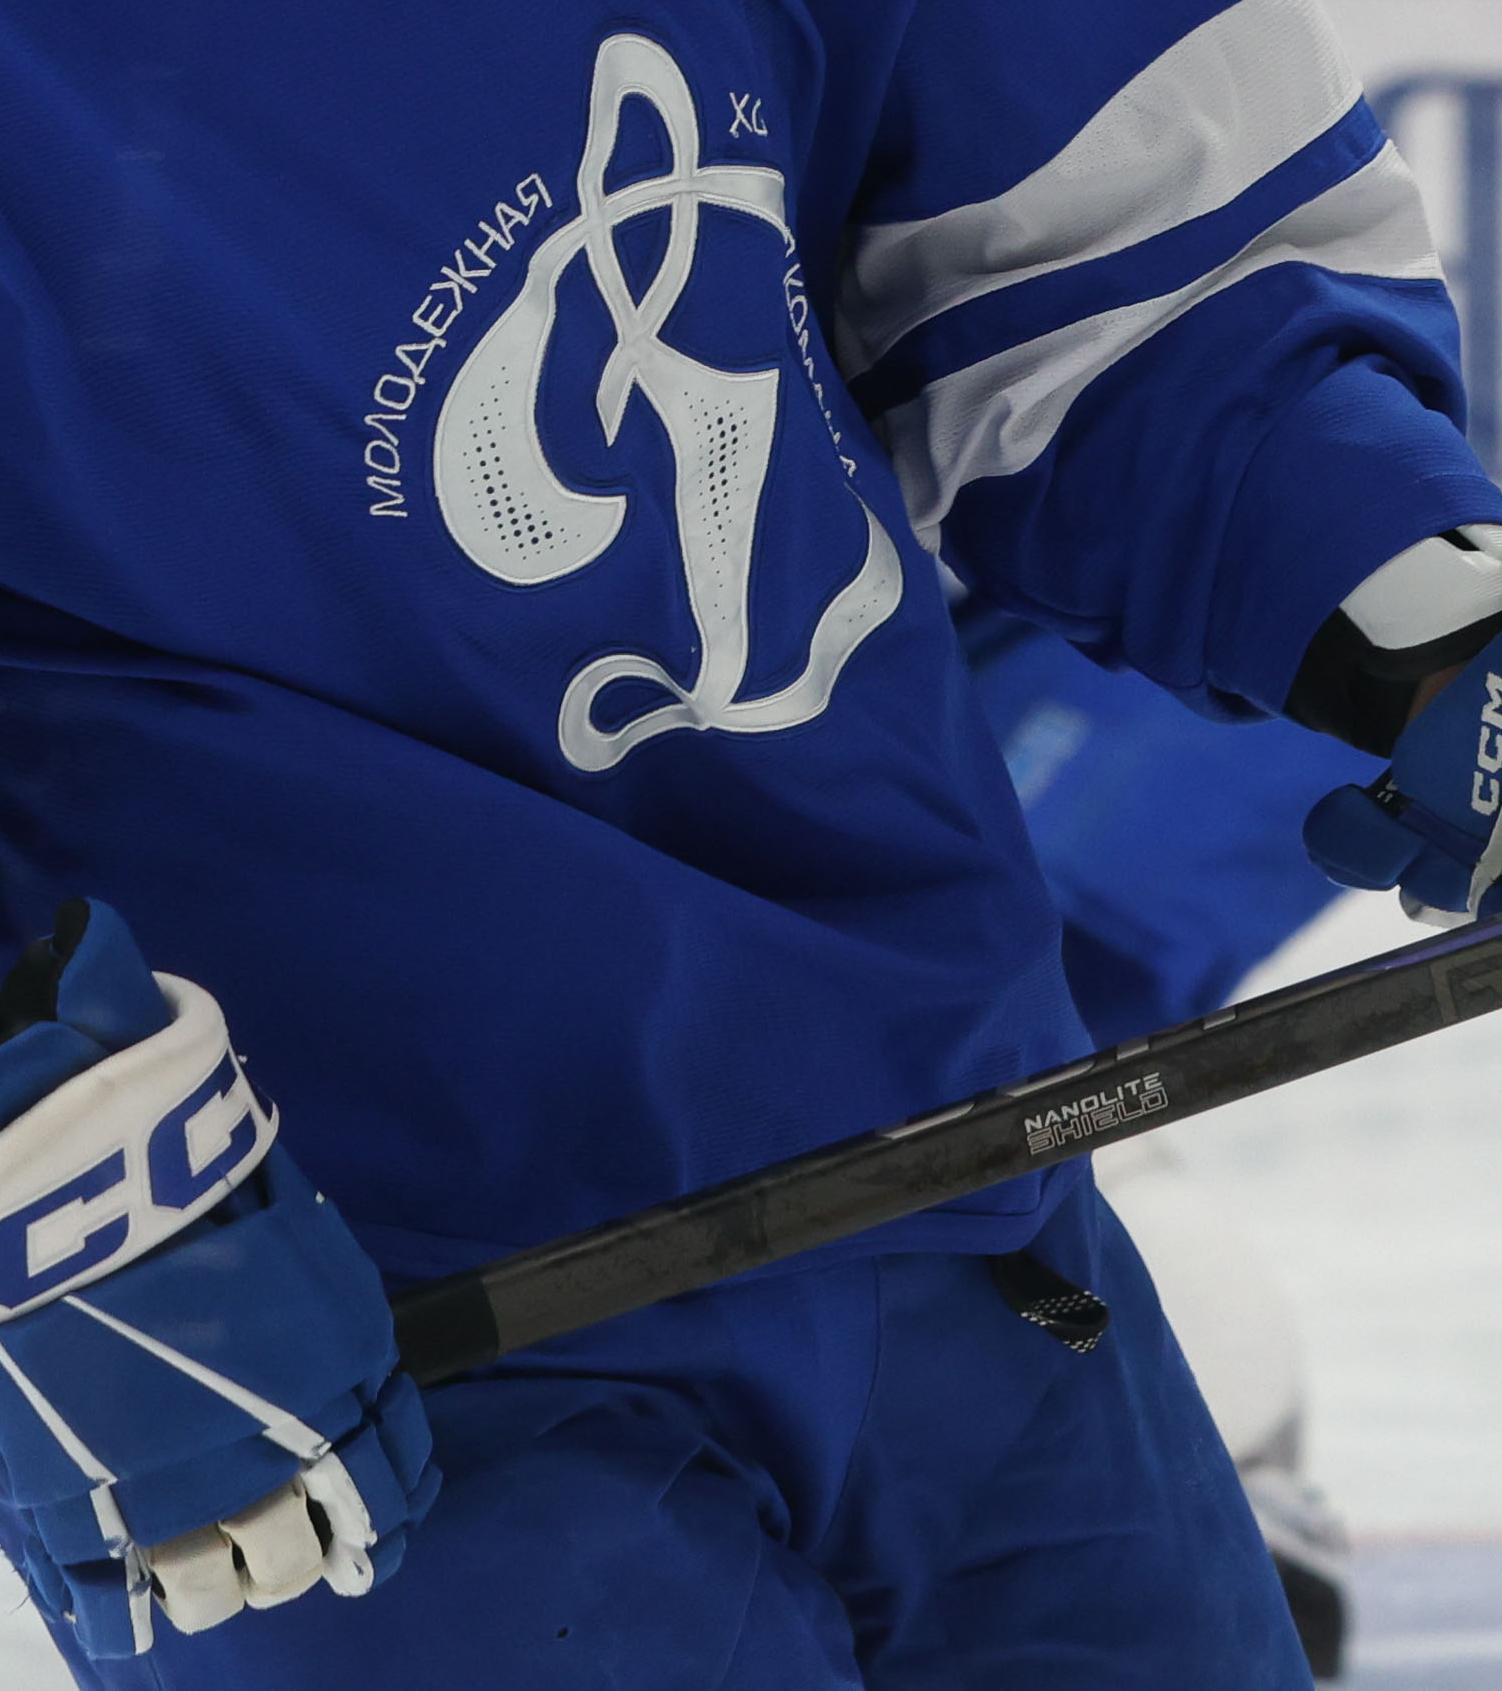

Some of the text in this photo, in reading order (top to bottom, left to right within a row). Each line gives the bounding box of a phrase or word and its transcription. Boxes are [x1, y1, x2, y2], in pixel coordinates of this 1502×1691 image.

[369, 173, 553, 517] МОЛОДЕЖНАЯ
[1024, 1072, 1163, 1134] NANOLITE
[1026, 1086, 1169, 1156] SHIELD
